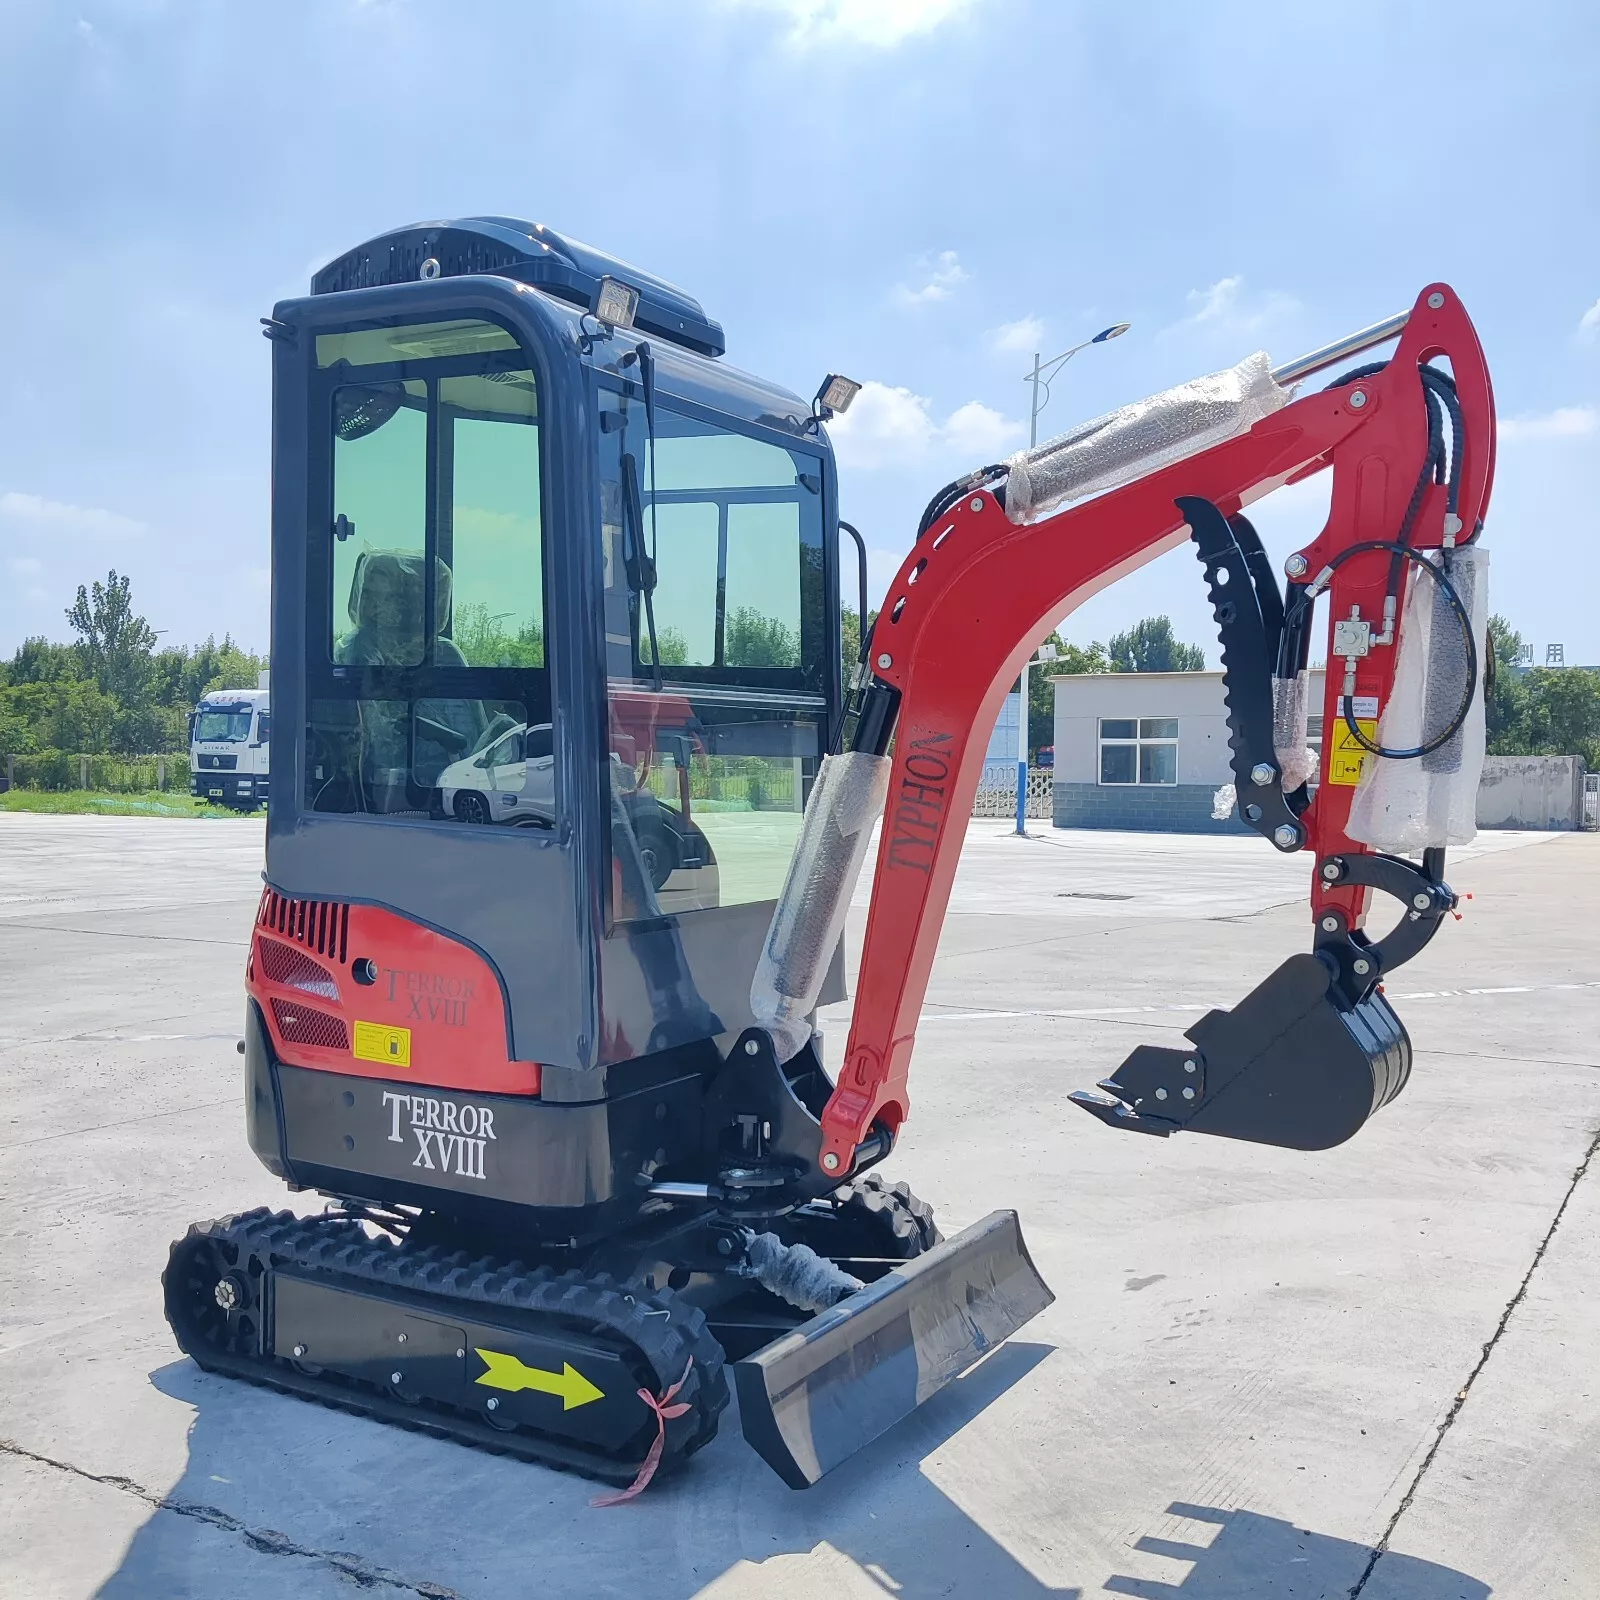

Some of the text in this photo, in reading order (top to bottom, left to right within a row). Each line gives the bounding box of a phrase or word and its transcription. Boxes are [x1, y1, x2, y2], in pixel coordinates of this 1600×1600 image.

[887, 733, 953, 875] TYPHON
[383, 968, 477, 1001] TERROR
[382, 1091, 497, 1142] TERROR
[412, 1127, 486, 1180] XVIII
